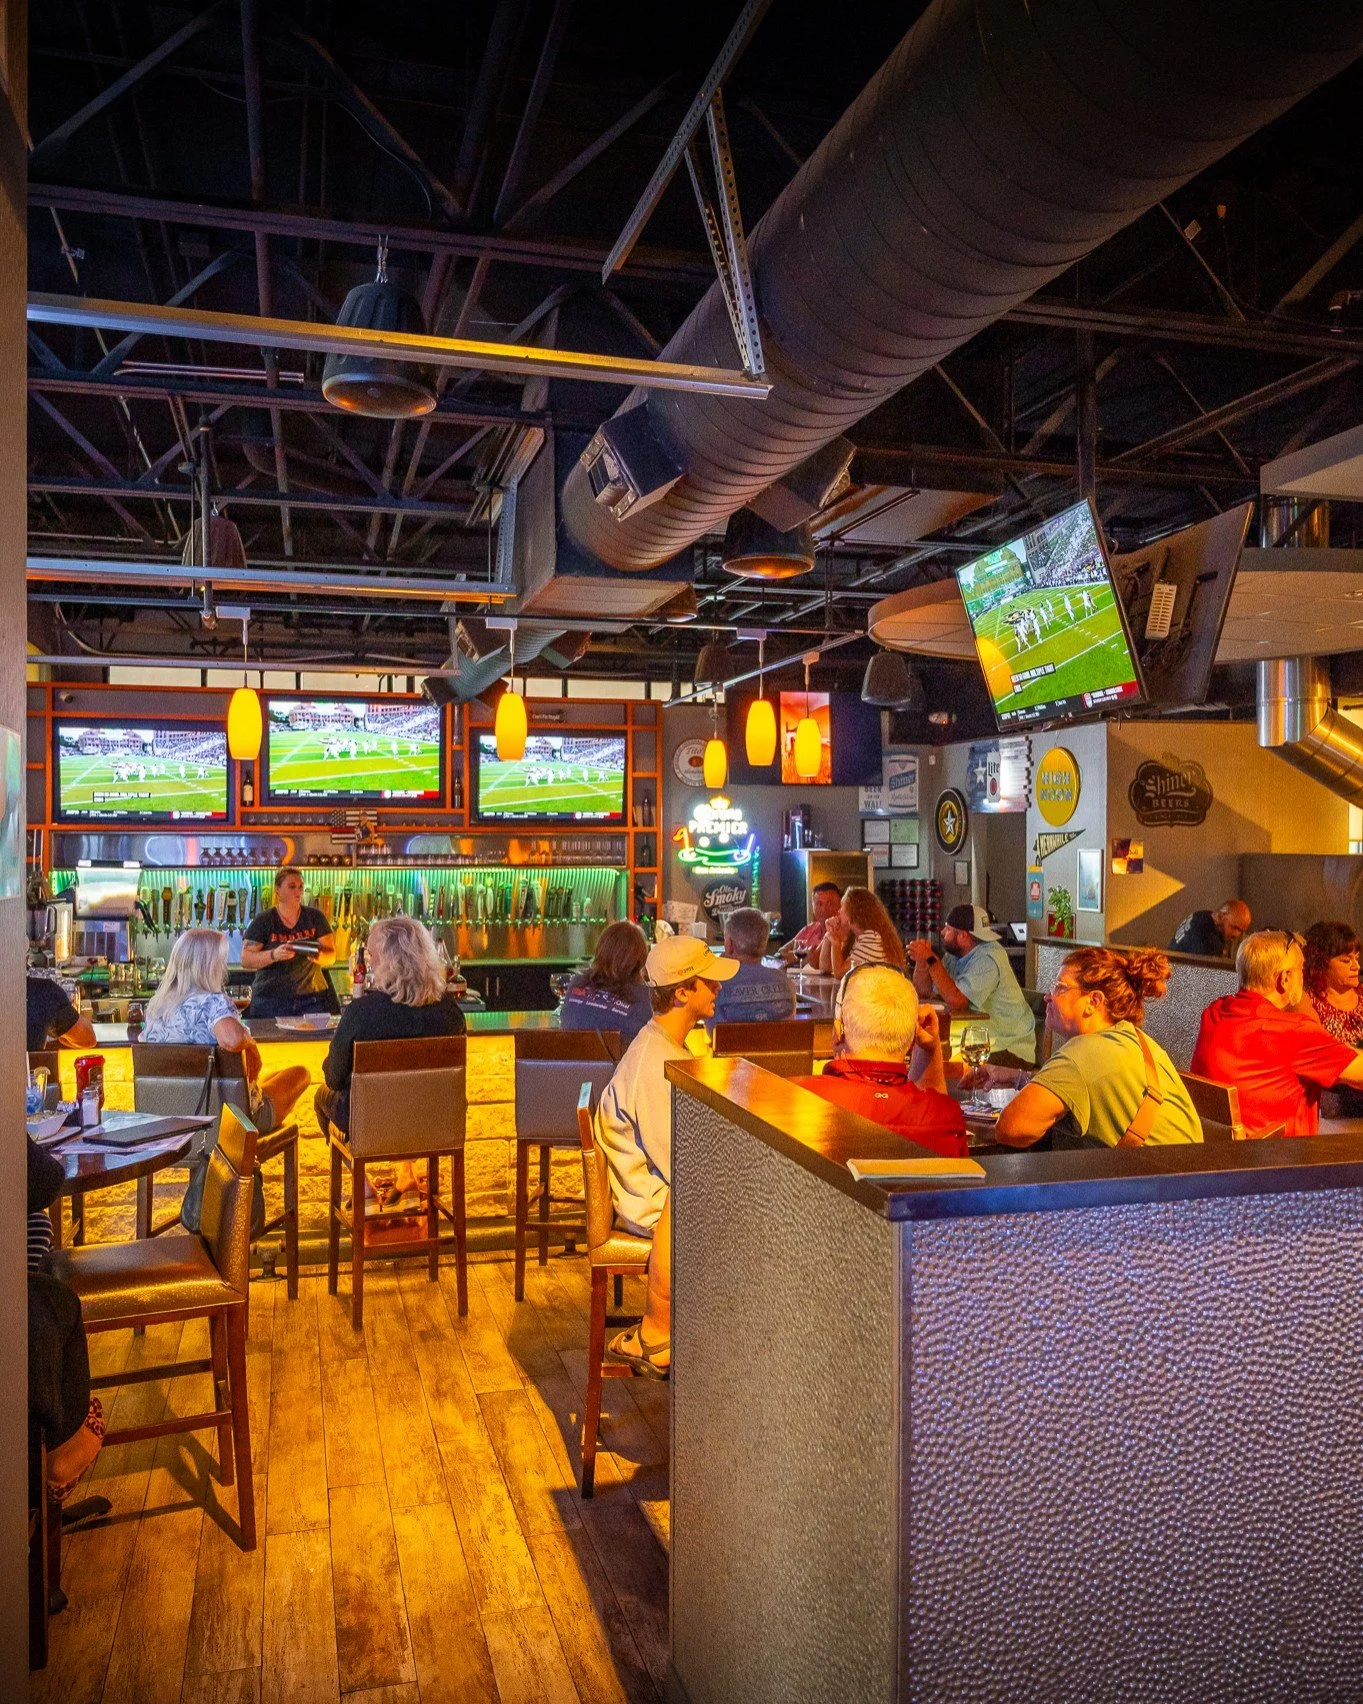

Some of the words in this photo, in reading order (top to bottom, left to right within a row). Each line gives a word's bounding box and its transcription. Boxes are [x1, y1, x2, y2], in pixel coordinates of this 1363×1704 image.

[988, 762, 1000, 777] Lite
[1042, 771, 1070, 784] HIGH
[1041, 788, 1072, 801] NOON
[704, 887, 746, 908] Smoky
